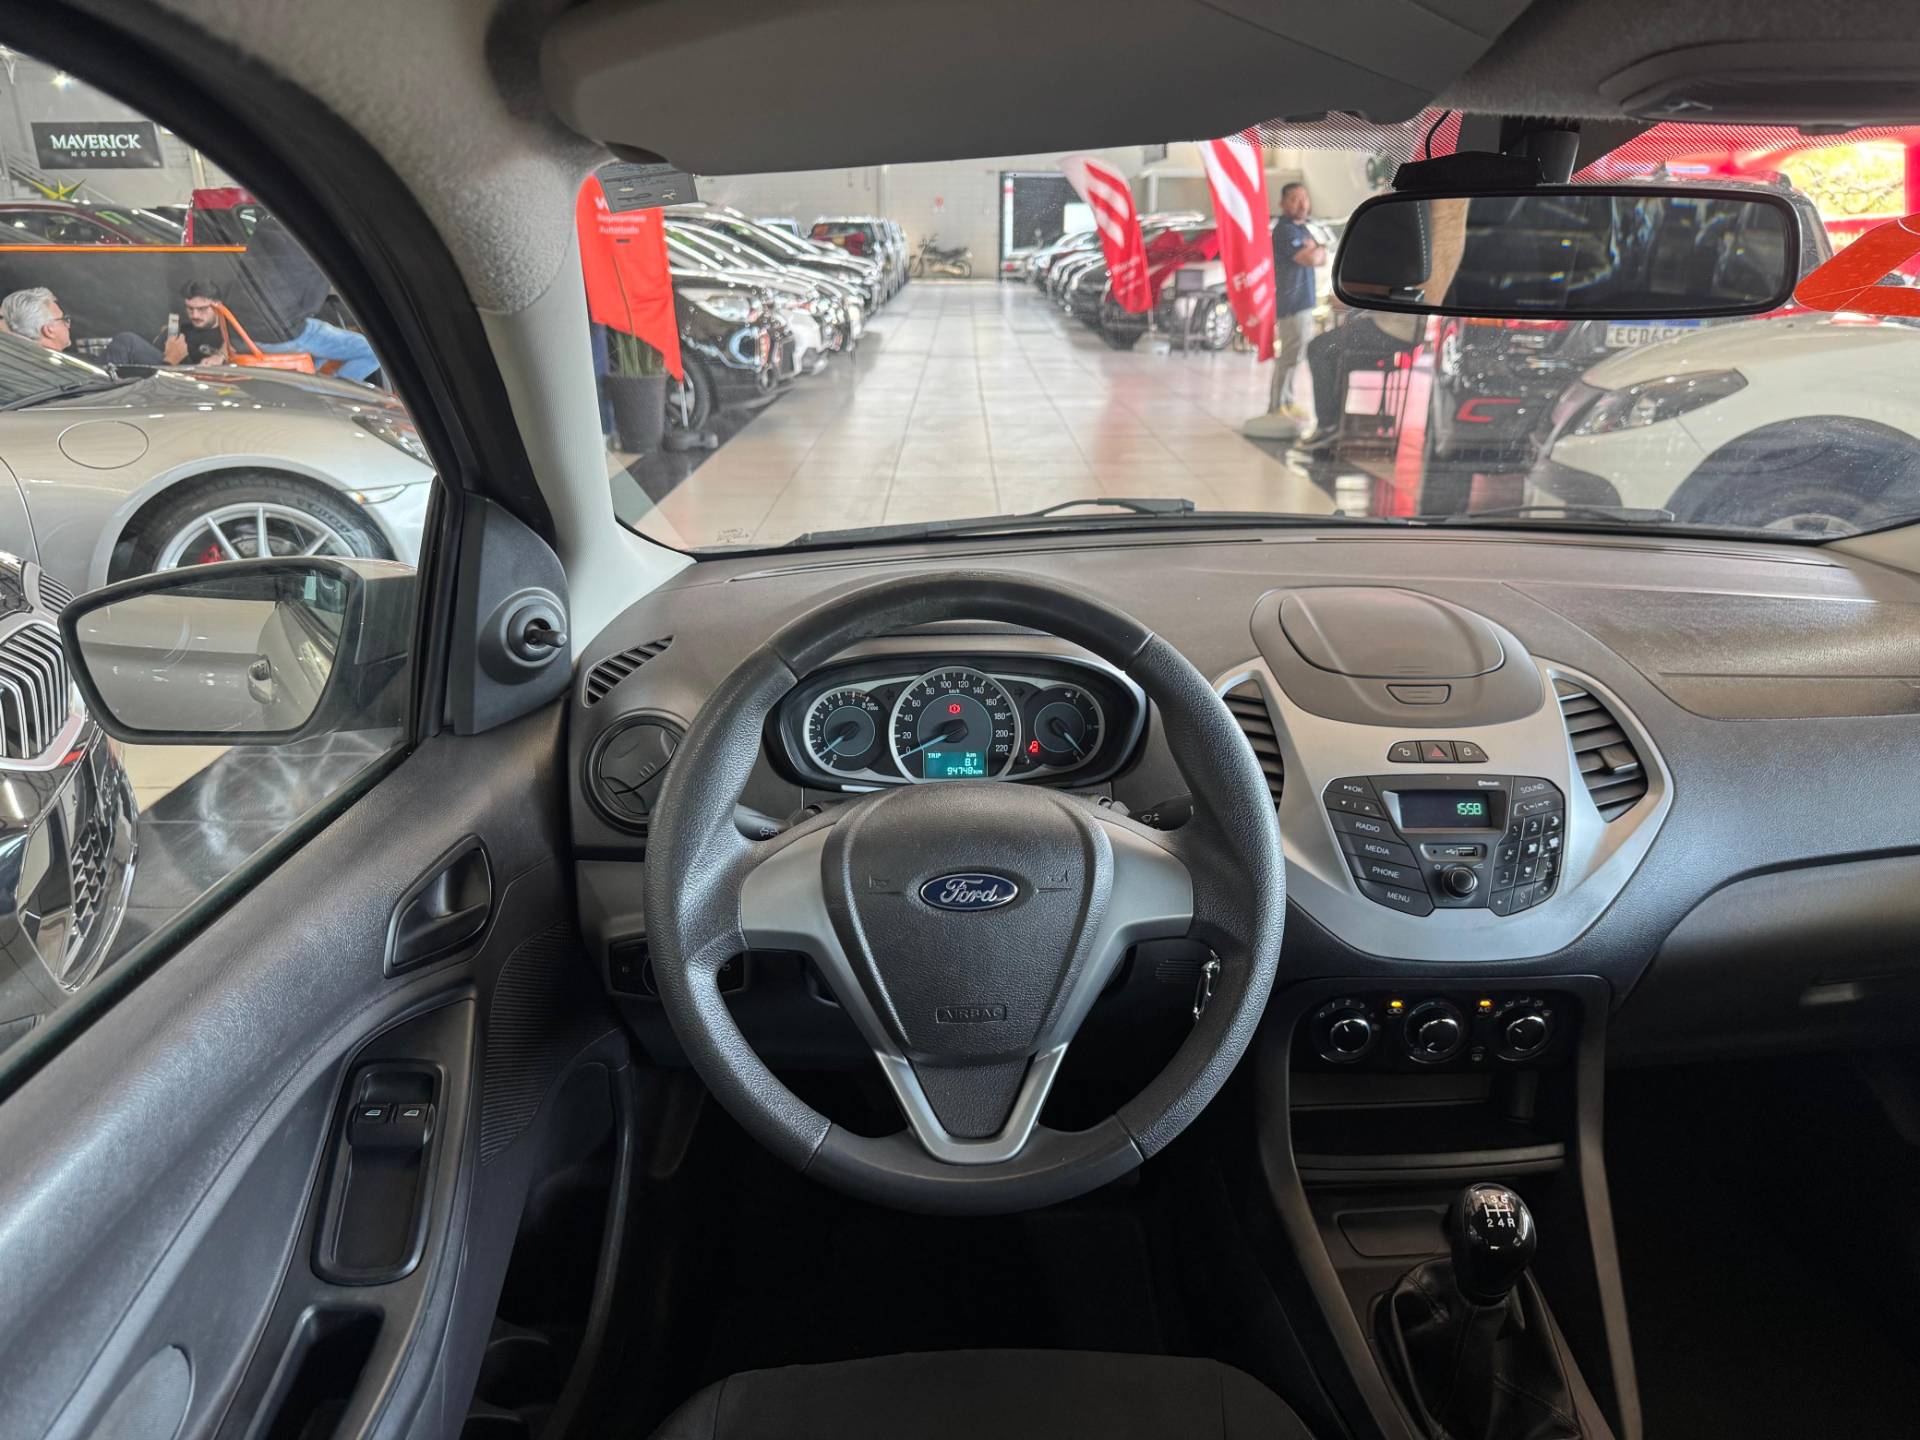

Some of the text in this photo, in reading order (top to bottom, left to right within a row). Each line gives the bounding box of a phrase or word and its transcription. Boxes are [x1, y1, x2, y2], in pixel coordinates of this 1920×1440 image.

[50, 134, 141, 149] MAVERICK
[926, 687, 934, 695] 80
[973, 686, 984, 694] 140
[904, 714, 912, 722] 40
[1520, 783, 1544, 794] SOUND
[1355, 822, 1380, 832] RADIO
[1365, 844, 1390, 855] MEDIA
[1372, 866, 1400, 878] PHONE
[940, 879, 997, 903] Ford
[1387, 892, 1410, 903] MENU
[1480, 1195, 1508, 1204] 1 3 5
[1486, 1218, 1516, 1228] 2 4 R
